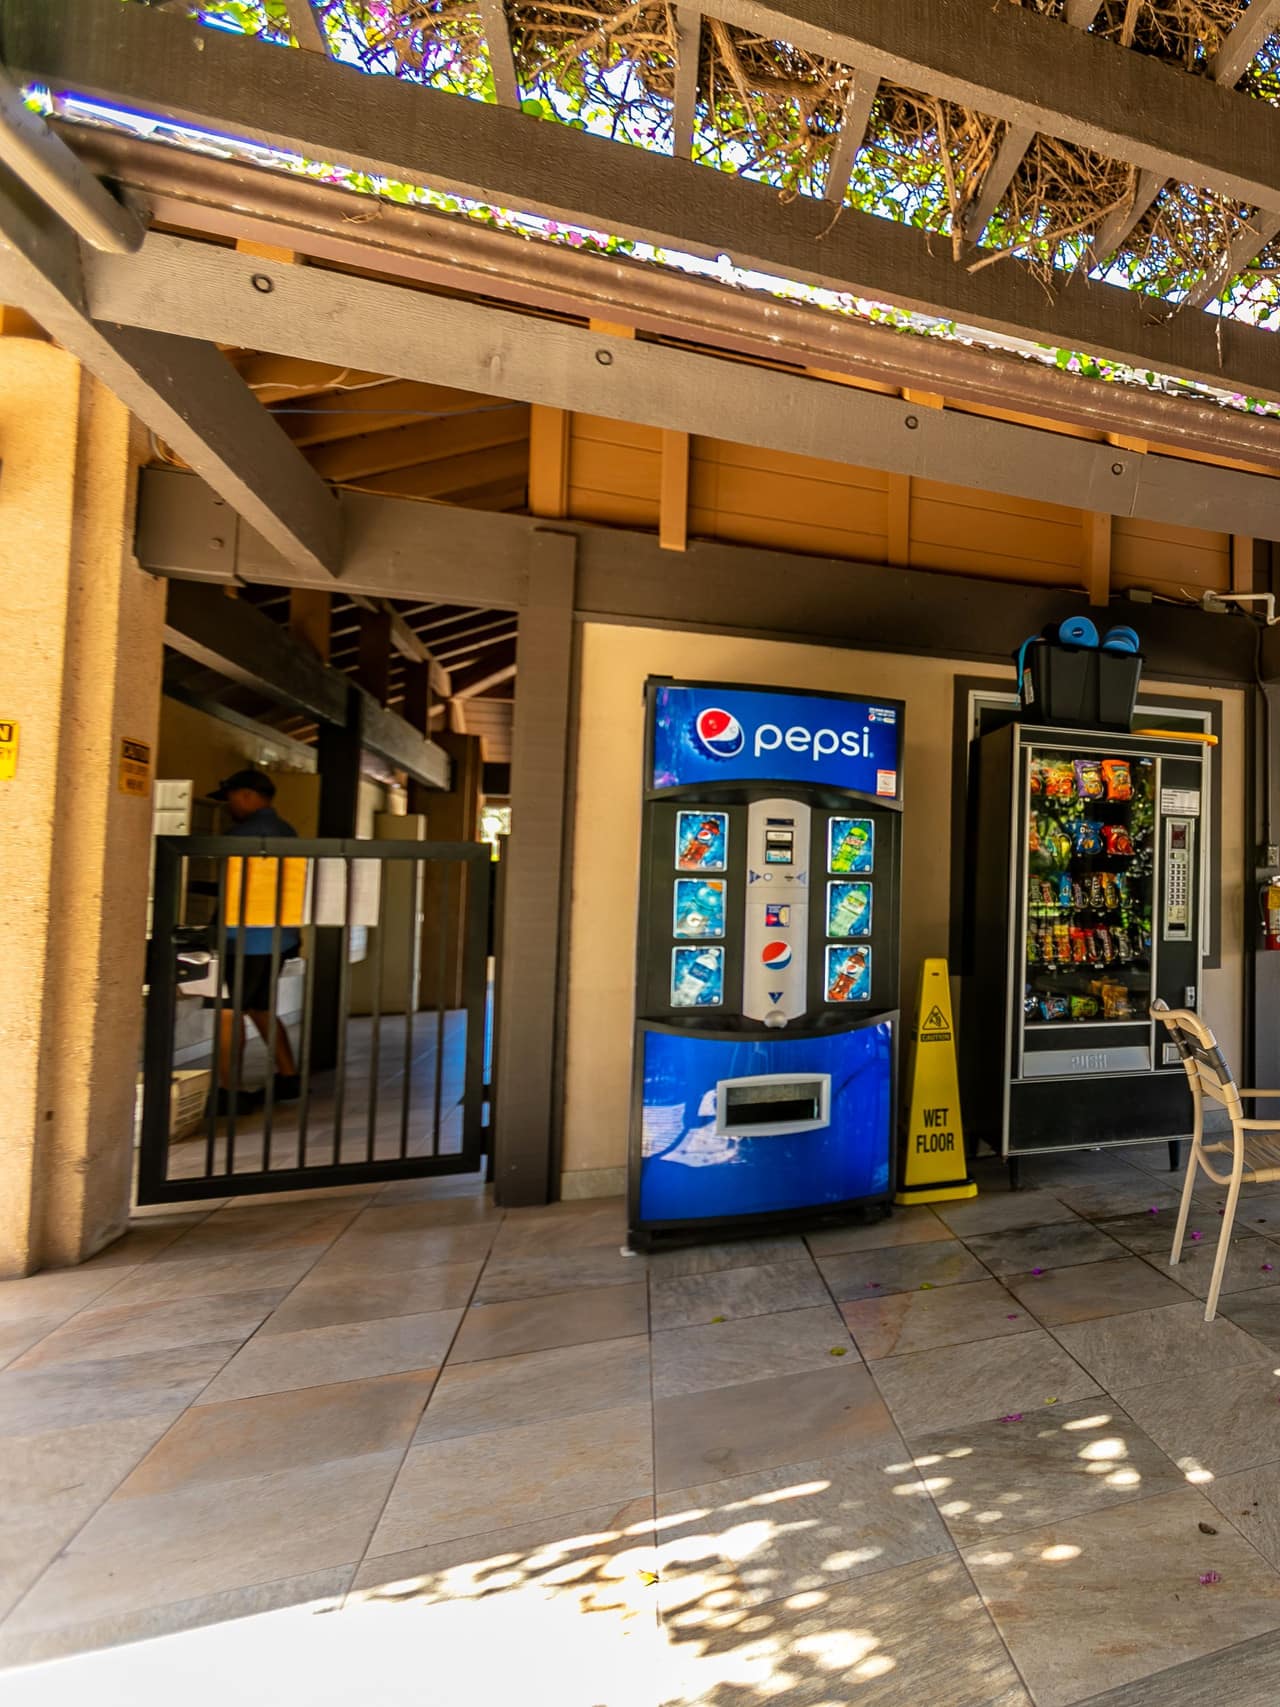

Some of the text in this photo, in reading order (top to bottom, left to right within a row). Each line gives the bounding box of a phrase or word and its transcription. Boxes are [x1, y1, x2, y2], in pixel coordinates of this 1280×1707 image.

[754, 723, 870, 761] pepsi
[923, 1108, 949, 1128] WET
[916, 1132, 954, 1153] FLOOR
